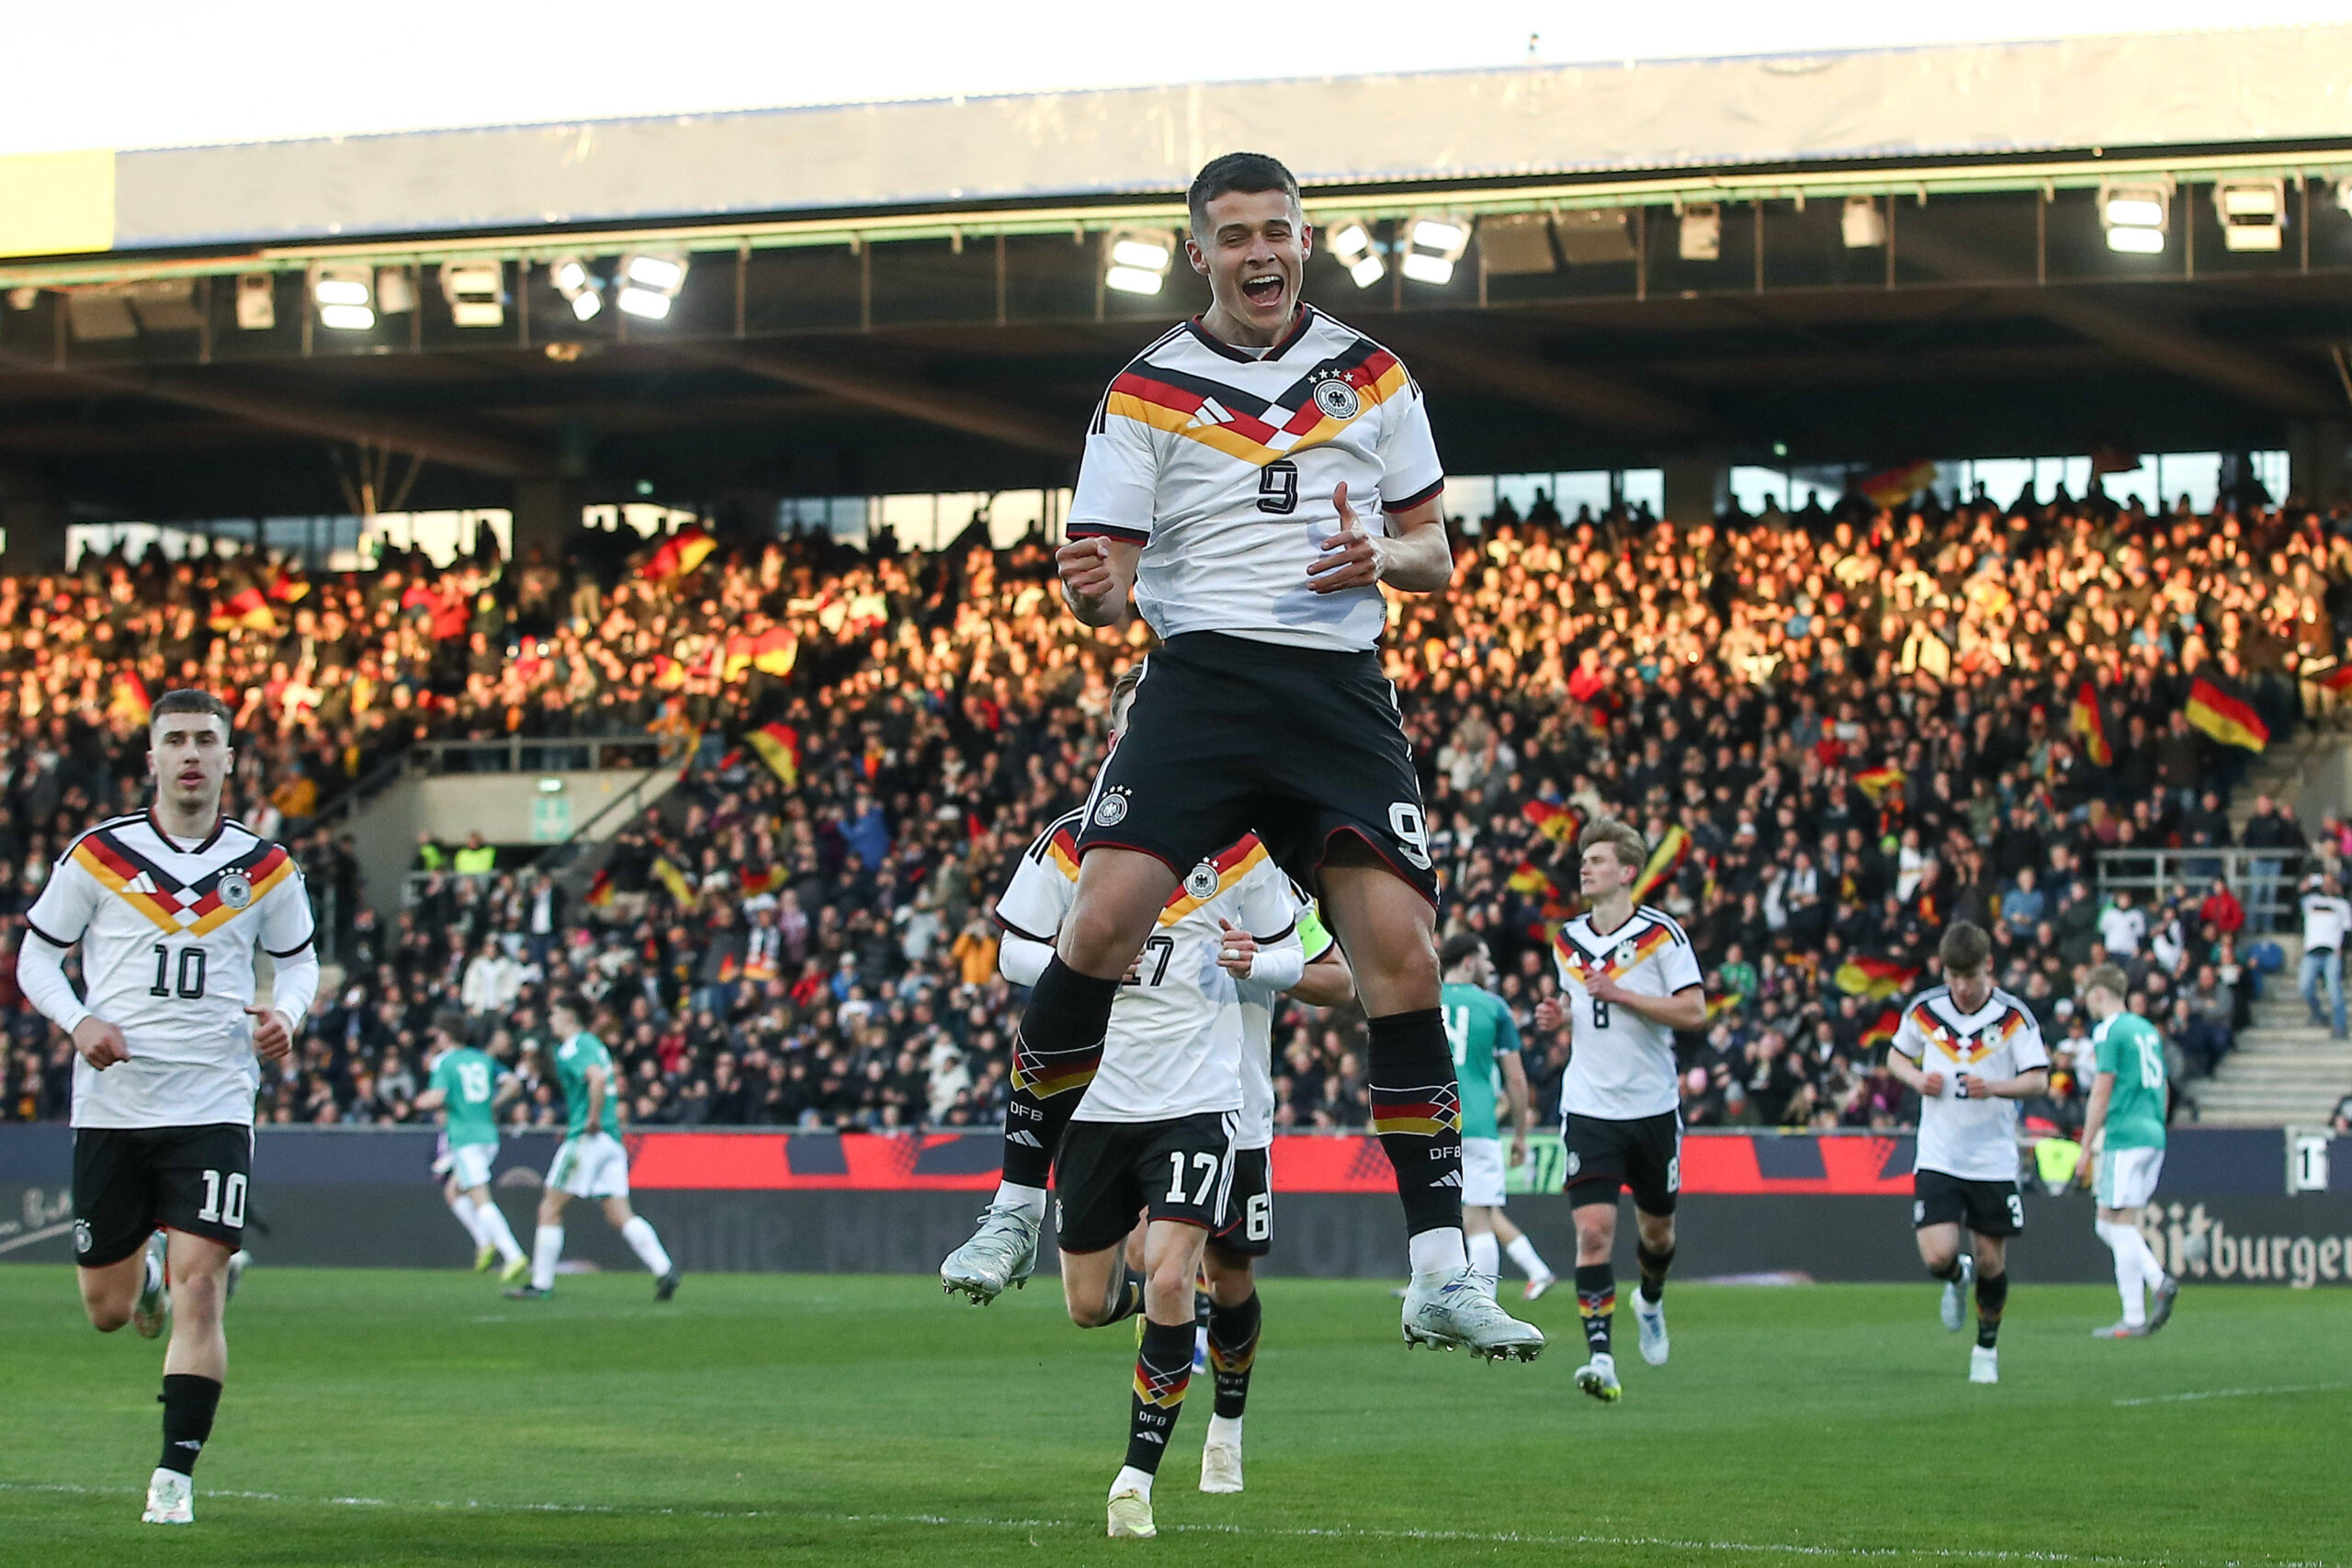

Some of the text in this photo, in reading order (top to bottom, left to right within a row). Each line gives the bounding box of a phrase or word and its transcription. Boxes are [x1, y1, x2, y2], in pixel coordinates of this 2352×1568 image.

[1256, 459, 1298, 514] 9
[1388, 802, 1432, 871] 9
[150, 944, 207, 999] 10
[1593, 995, 1610, 1029] 8
[1011, 1100, 1044, 1122] DFB
[1430, 1145, 1461, 1160] DFB
[198, 1169, 247, 1229] 10
[1165, 1151, 1218, 1206] 17
[1247, 1192, 1270, 1241] 6
[2007, 1194, 2024, 1228] 3
[1138, 1410, 1167, 1427] DFB
